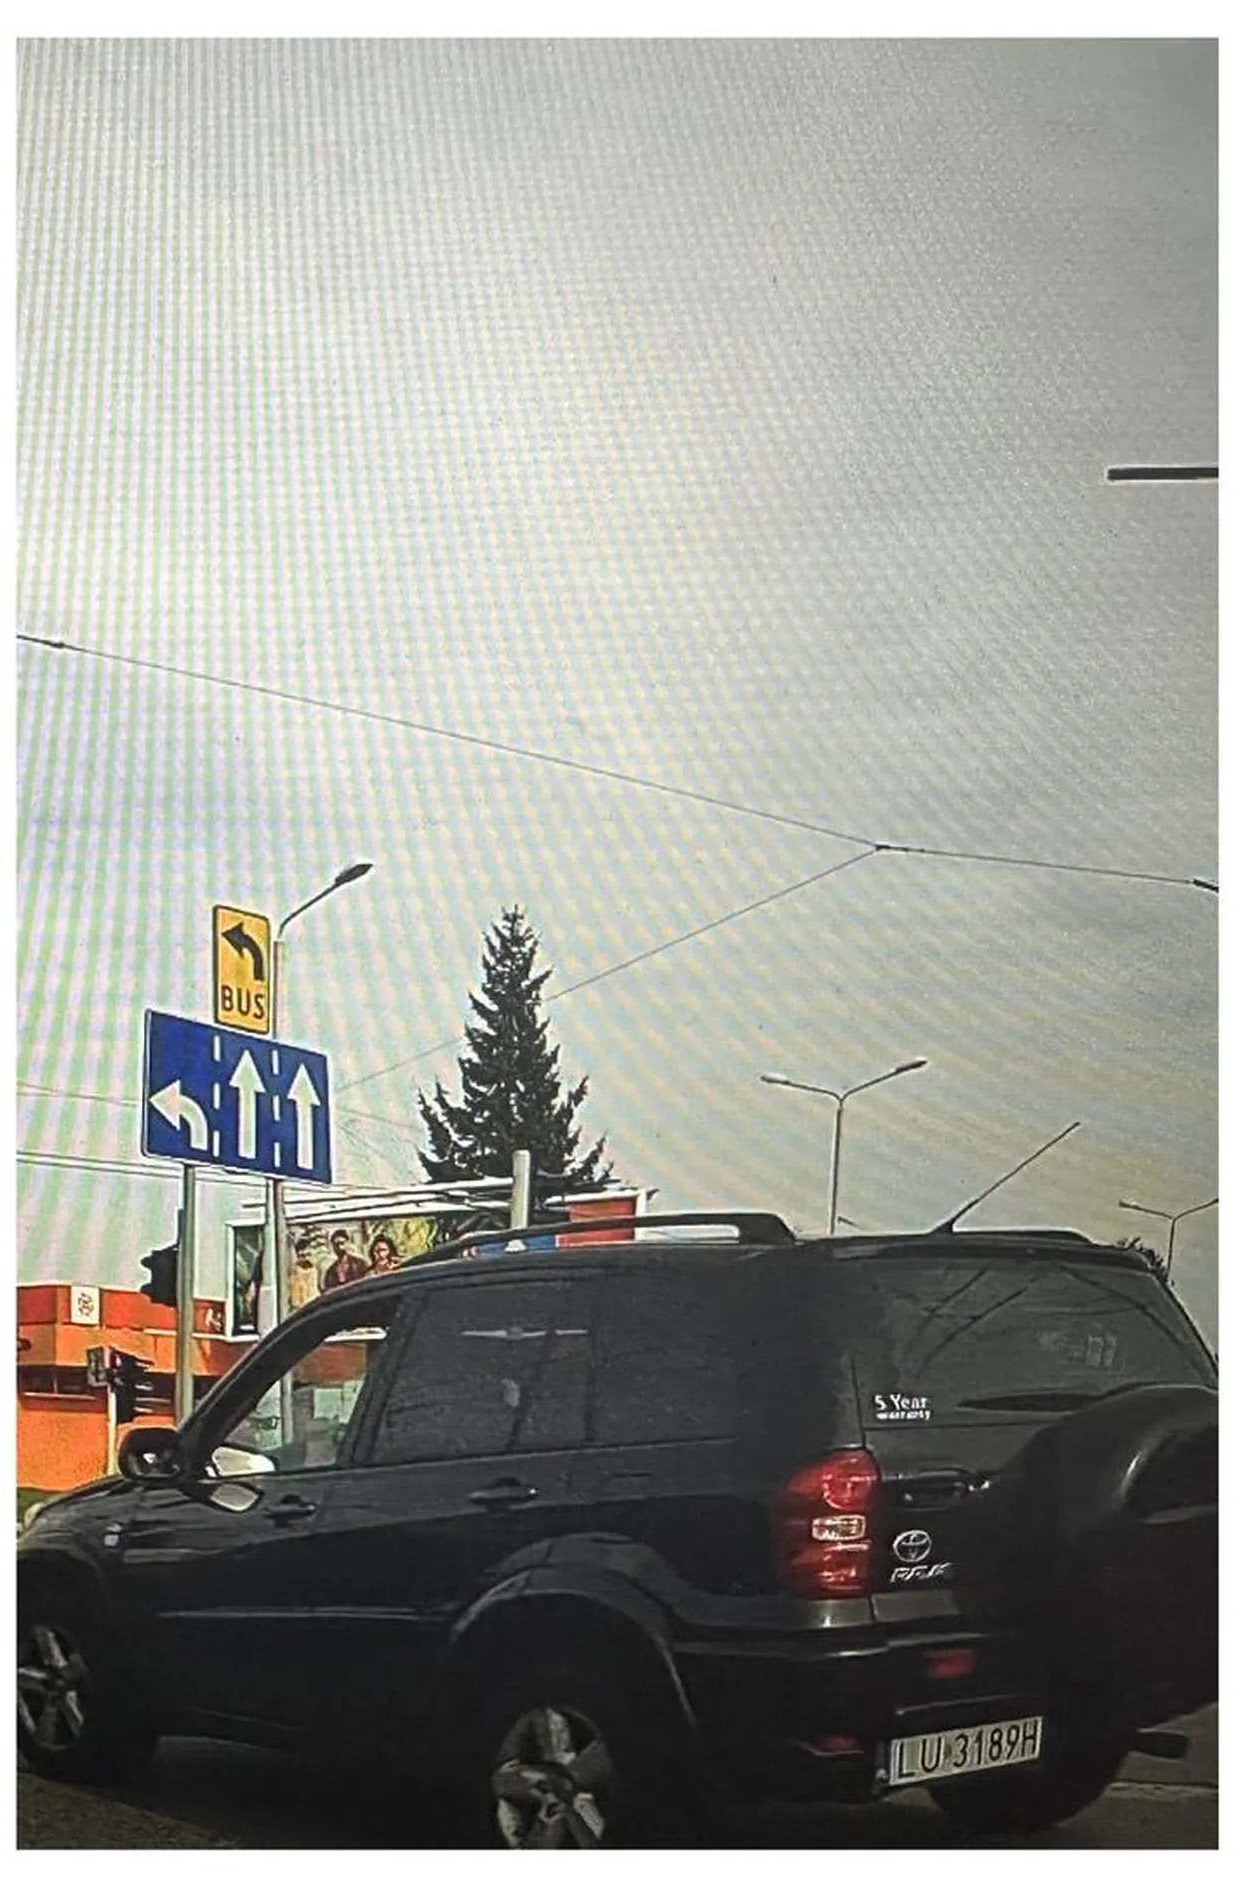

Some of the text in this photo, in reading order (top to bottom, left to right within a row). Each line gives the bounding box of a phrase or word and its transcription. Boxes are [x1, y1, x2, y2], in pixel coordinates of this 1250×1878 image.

[221, 984, 265, 1019] BUS
[874, 1393, 928, 1411] 5 Year
[898, 1719, 1039, 1779] LU 3189H
